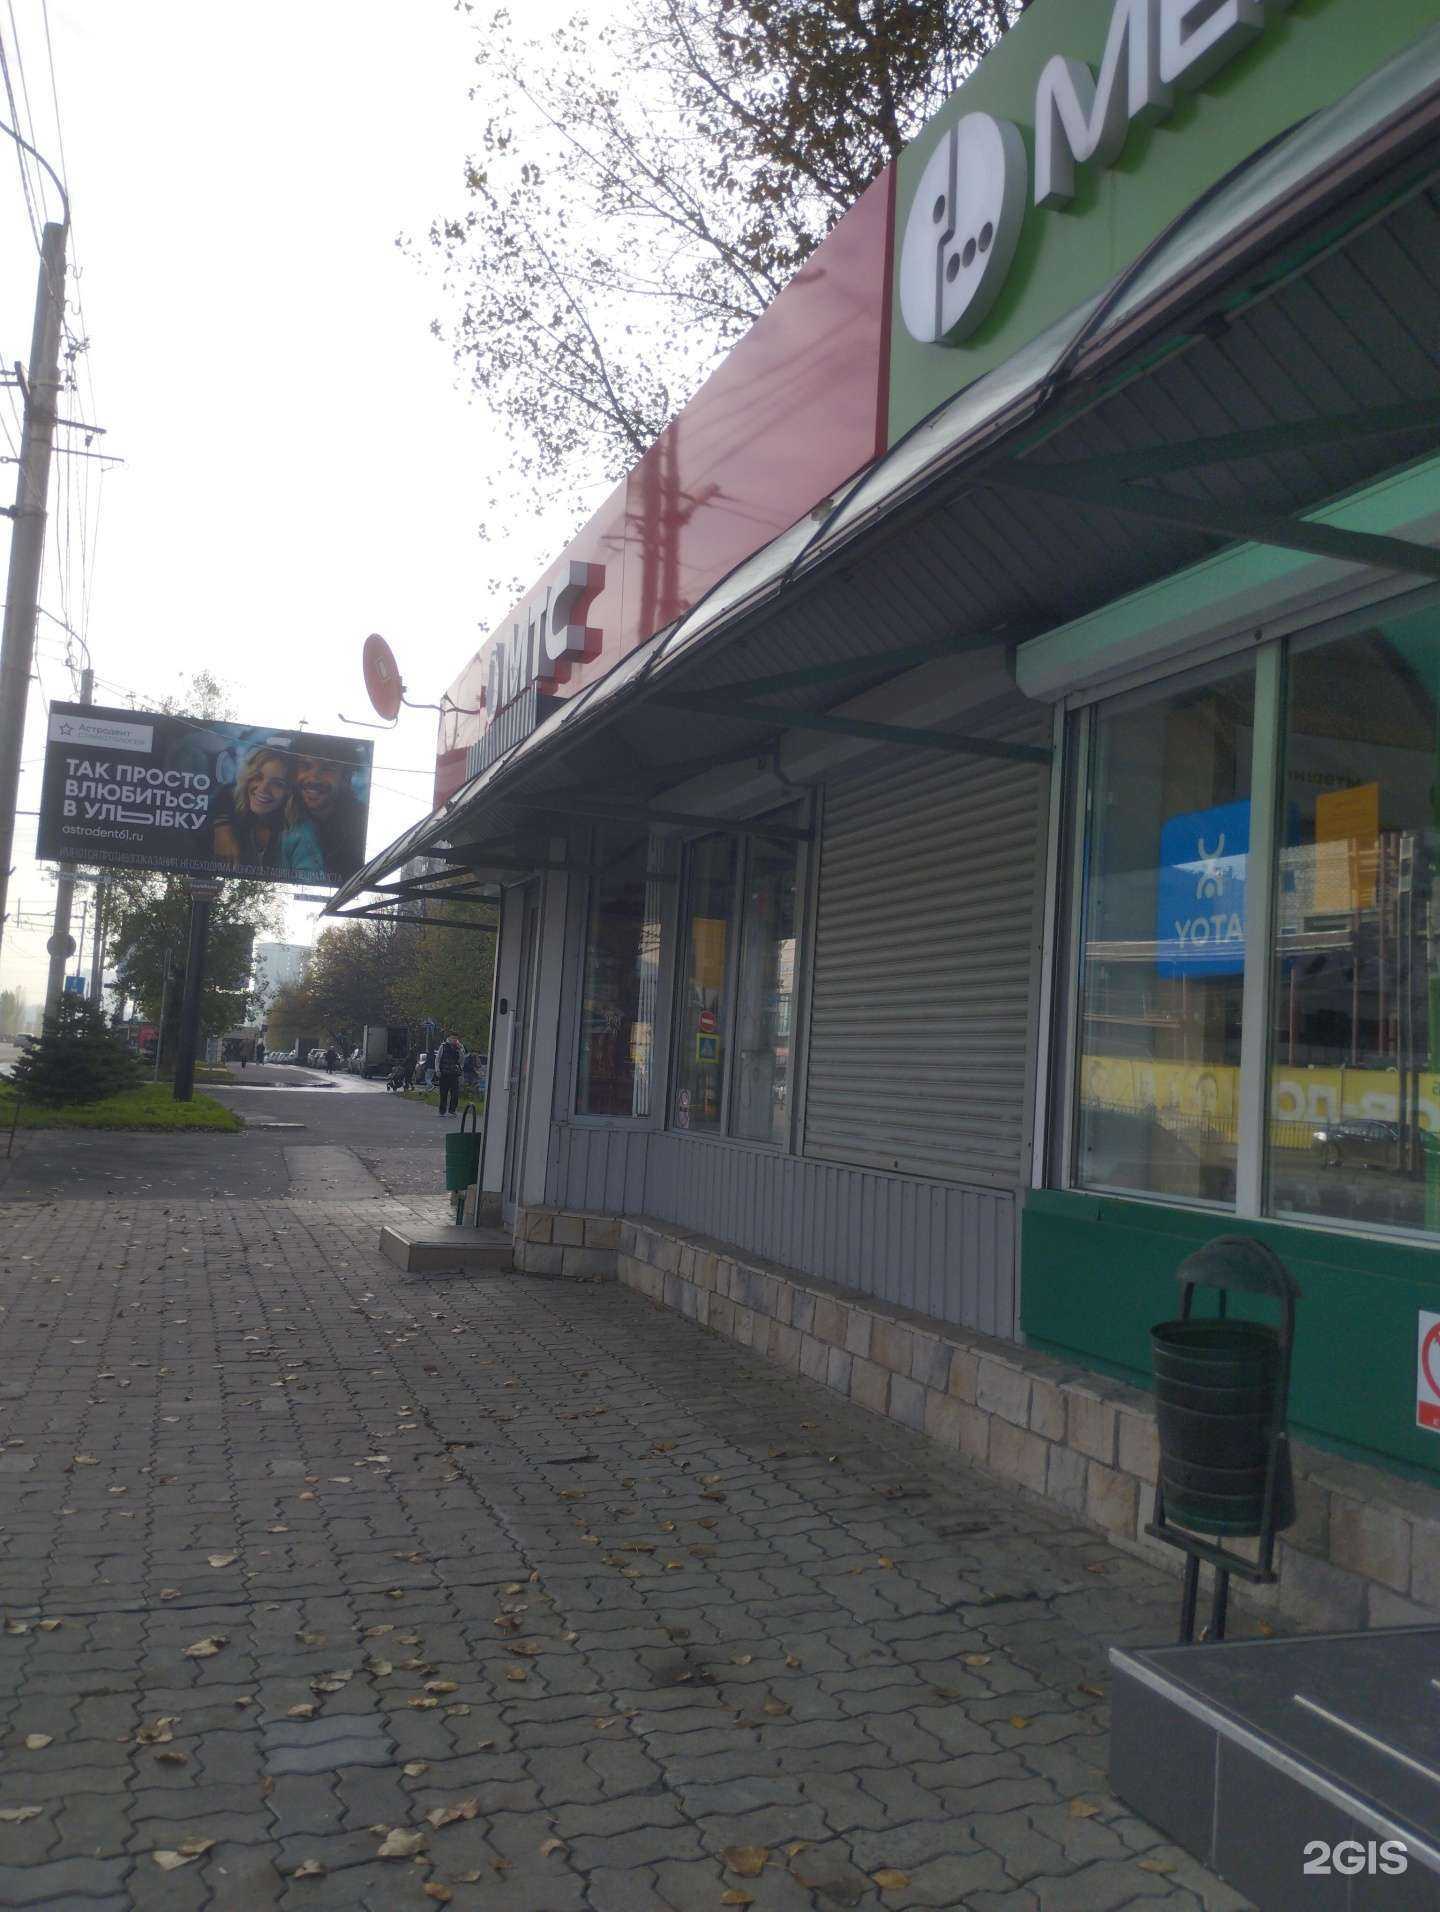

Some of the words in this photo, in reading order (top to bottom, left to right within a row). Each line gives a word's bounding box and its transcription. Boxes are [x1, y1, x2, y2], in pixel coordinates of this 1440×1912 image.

[65, 758, 110, 780] ТАК
[116, 764, 211, 791] ПРОСТО
[65, 779, 209, 811] ВЛЮБИТЬСЯ
[63, 800, 77, 817] В
[84, 801, 207, 830] УЛЫБКУ
[62, 824, 144, 841] astrodent61.ru
[1174, 913, 1248, 950] YOTA
